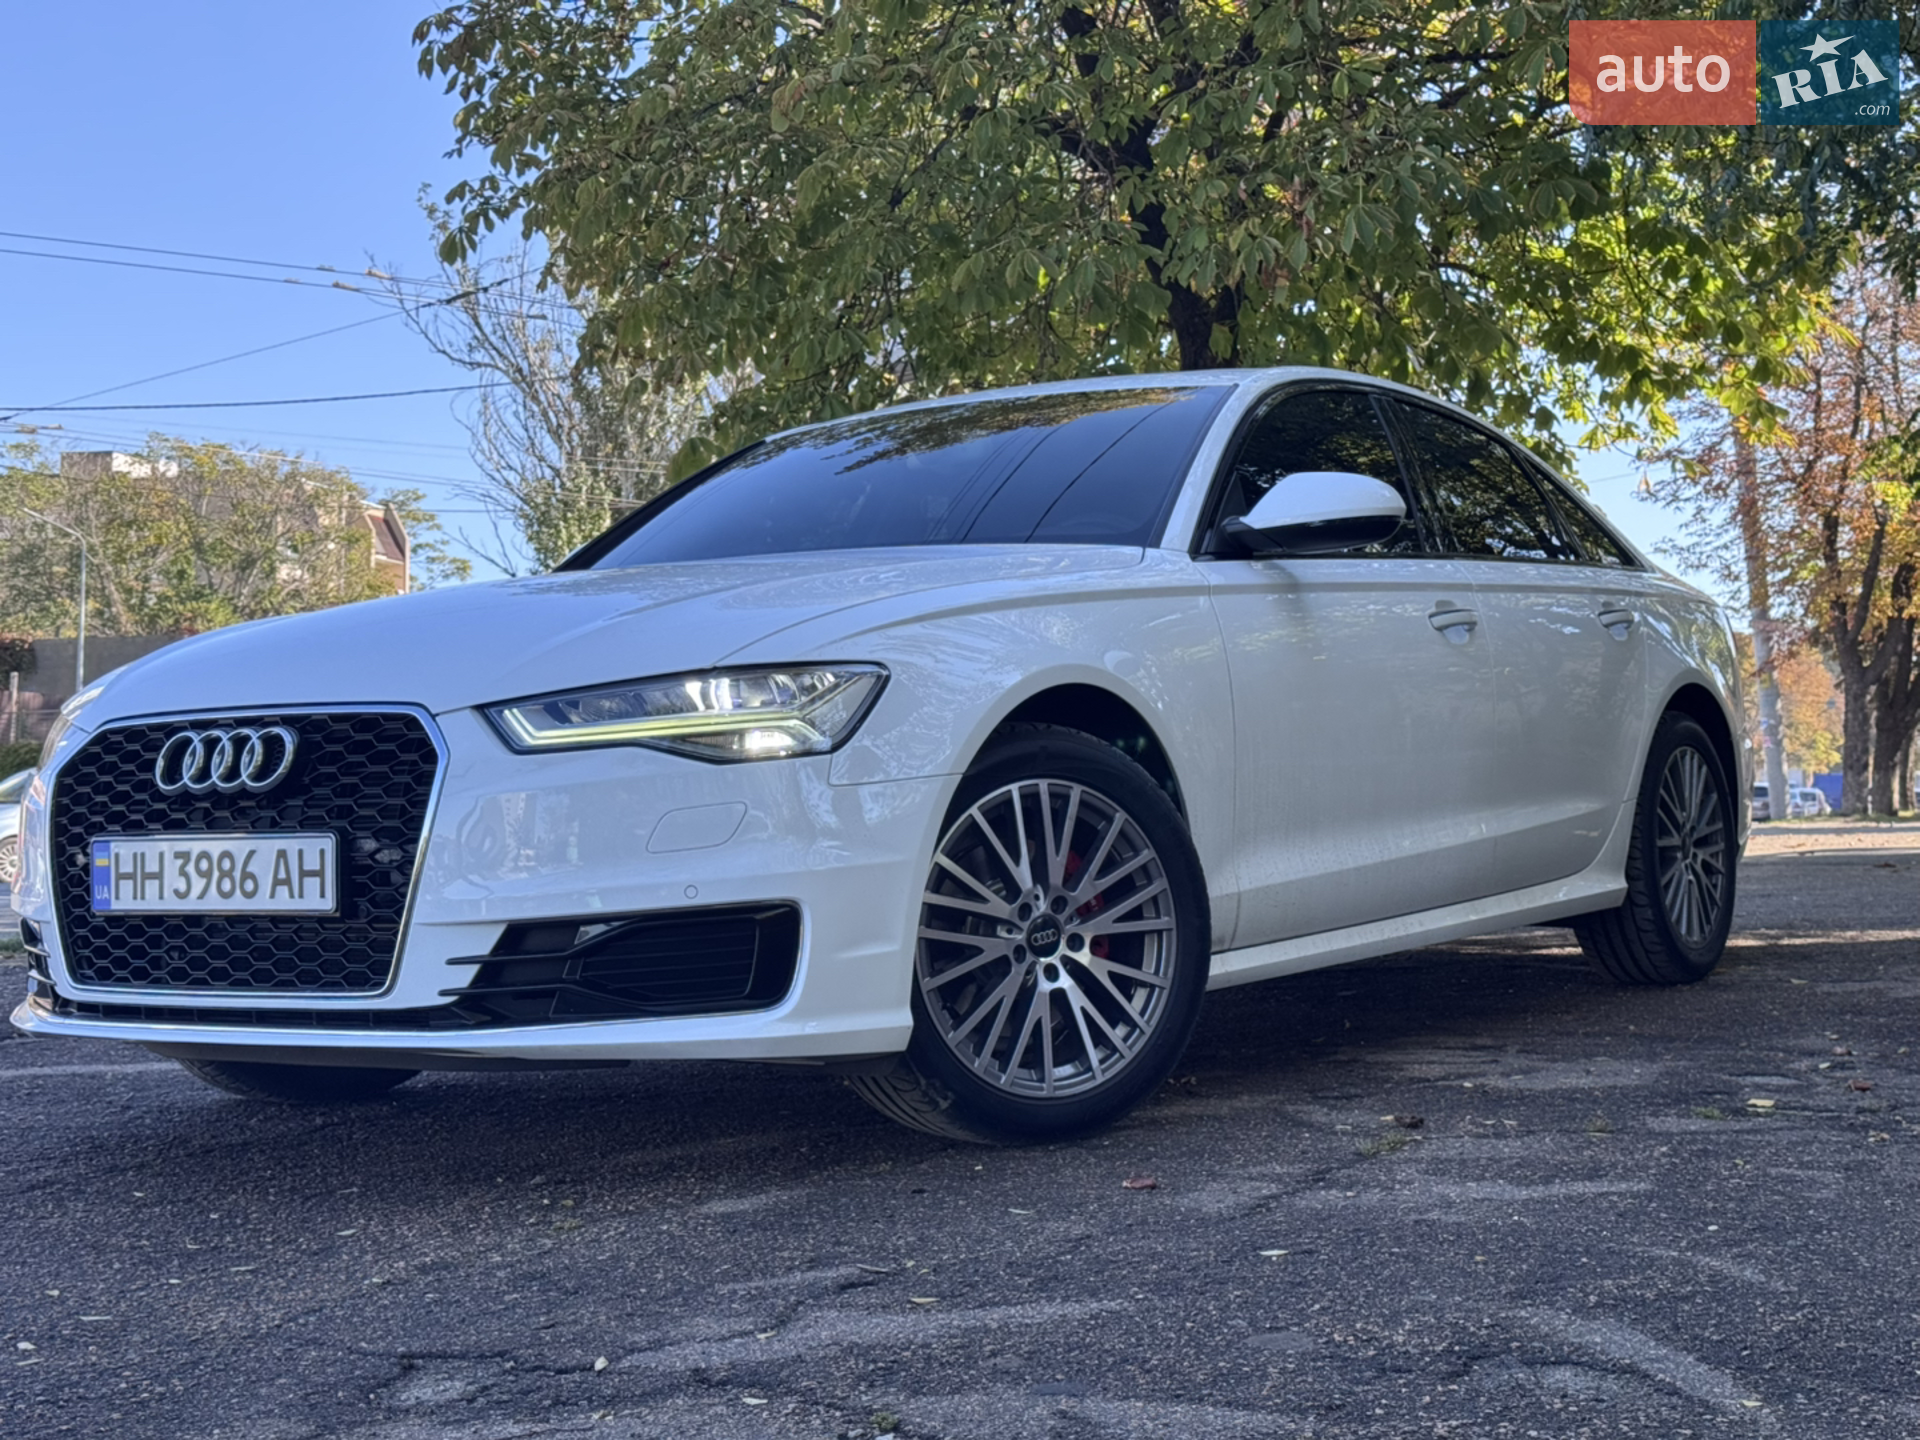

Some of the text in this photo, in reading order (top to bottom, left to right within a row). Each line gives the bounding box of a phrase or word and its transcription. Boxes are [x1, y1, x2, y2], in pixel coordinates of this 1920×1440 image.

[114, 848, 326, 900] HH 3986 AH
[95, 885, 110, 900] UA
